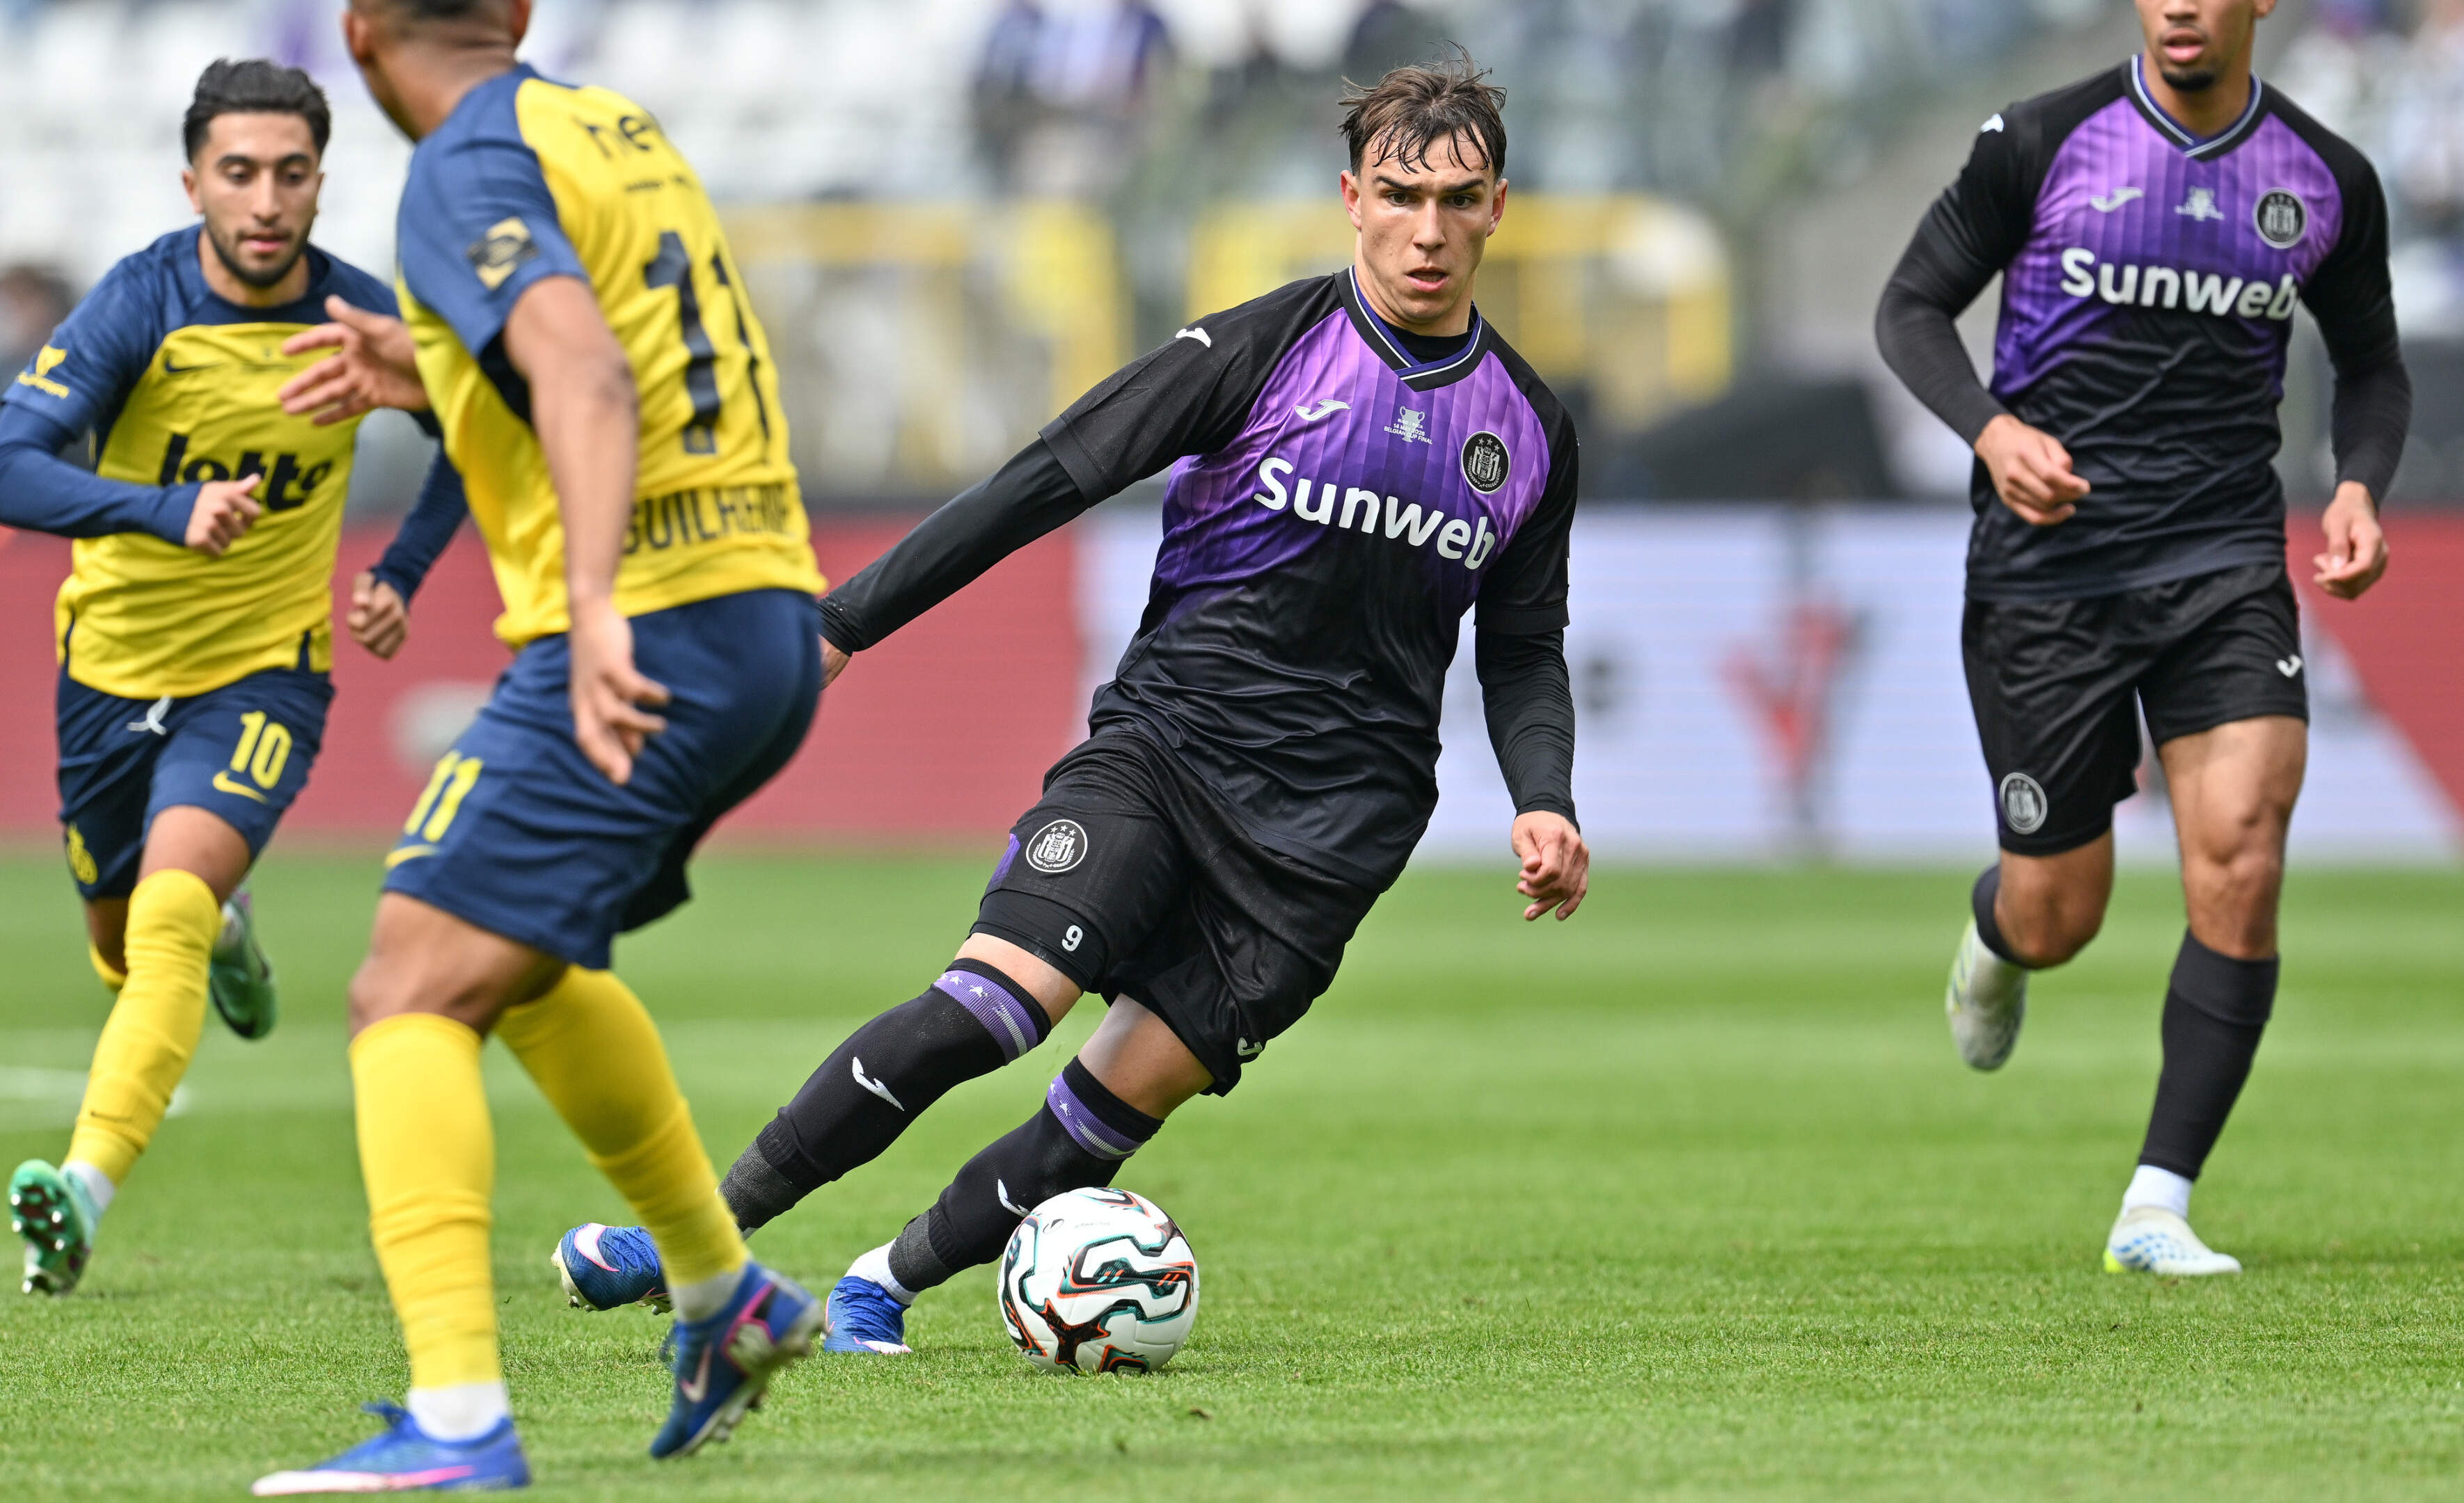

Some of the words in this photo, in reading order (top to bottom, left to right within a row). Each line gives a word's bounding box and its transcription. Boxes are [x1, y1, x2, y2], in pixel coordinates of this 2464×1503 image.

[2060, 247, 2297, 321] Sunweb
[642, 230, 771, 463] 11
[1384, 426, 1406, 436] BELGIAN
[1418, 436, 1433, 445] FINAL
[1253, 456, 1496, 571] Sunweb
[229, 710, 292, 790] 10
[404, 750, 483, 843] 11
[1061, 925, 1084, 952] 9
